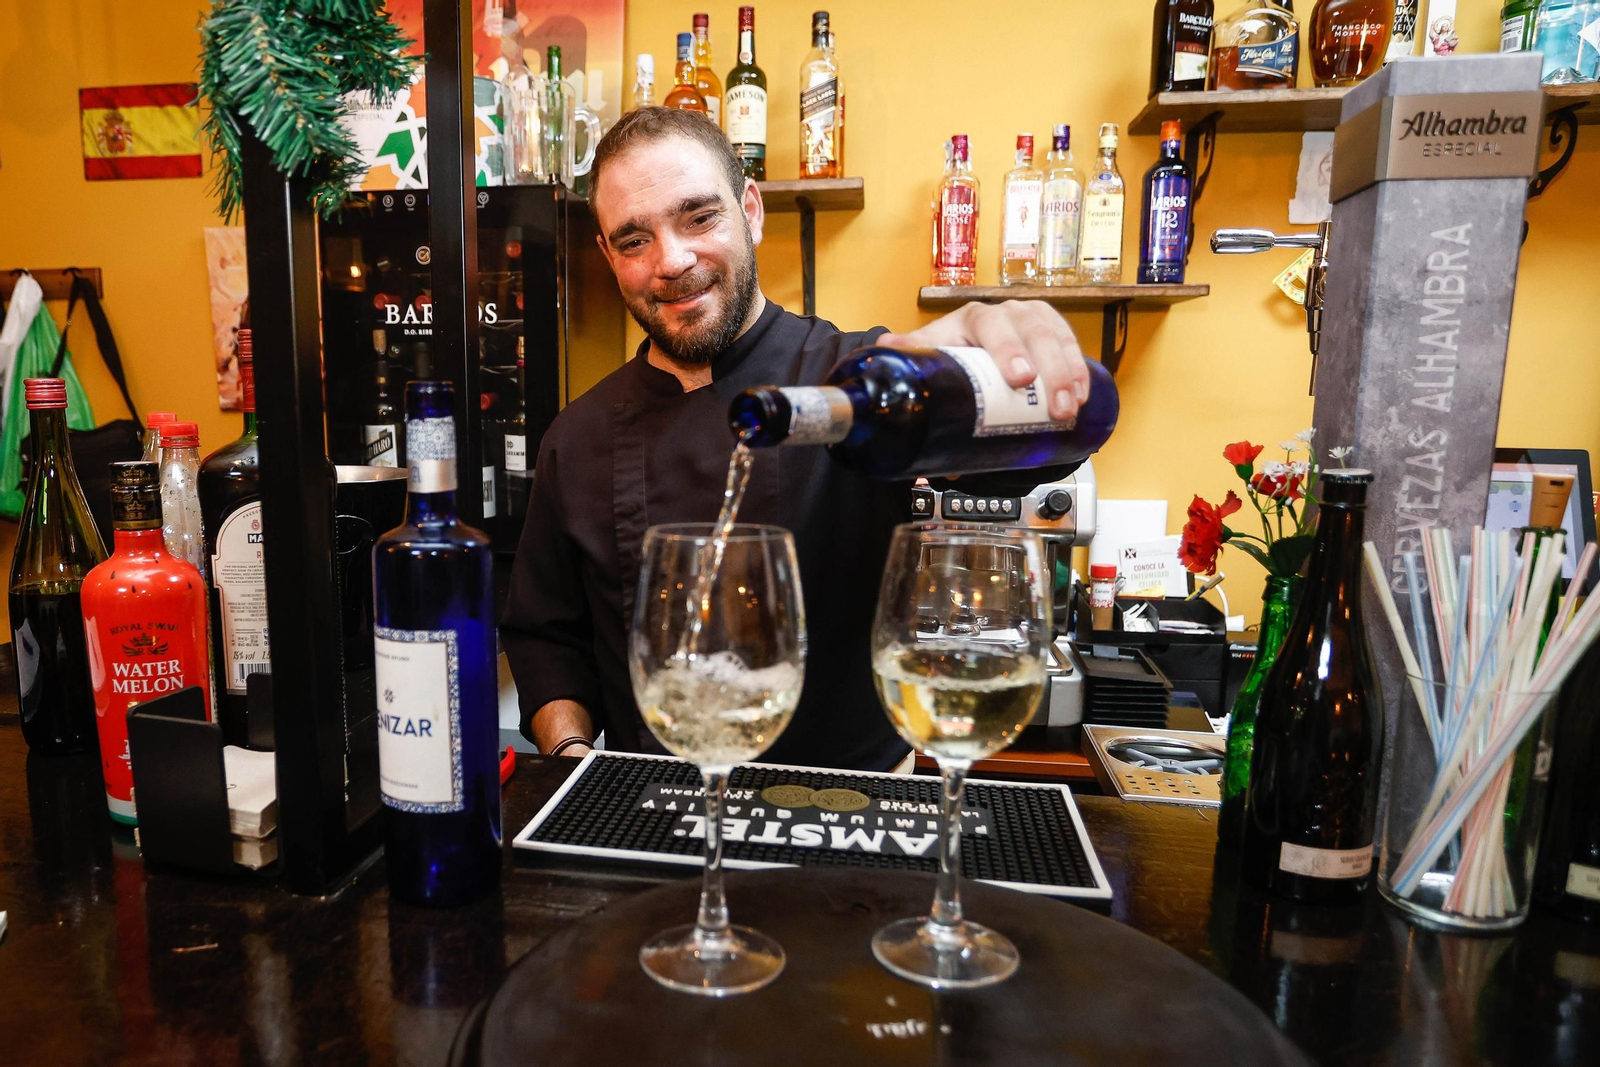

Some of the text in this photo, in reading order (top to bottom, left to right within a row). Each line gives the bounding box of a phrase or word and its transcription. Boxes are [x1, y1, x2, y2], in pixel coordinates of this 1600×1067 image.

[1331, 23, 1382, 32] FRANCISCO
[1334, 29, 1378, 37] MONTERO
[726, 90, 765, 104] JAMESON
[1399, 109, 1528, 141] Alhambra
[1422, 141, 1502, 157] ESPECIAL
[1040, 201, 1079, 216] LARIOS
[1153, 196, 1187, 210] LARIOS
[1162, 210, 1179, 229] 12
[384, 303, 498, 324] BARS
[1391, 223, 1473, 594] CERVEZAS ALHAMBRA
[1133, 562, 1166, 572] CONOCE LA
[109, 622, 179, 636] ROYAL SWAN
[112, 660, 181, 677] WATER
[112, 674, 184, 694] MELON
[376, 708, 433, 737] ENIZAR
[641, 798, 793, 820] QUAITY
[819, 811, 988, 835] PEMIUM
